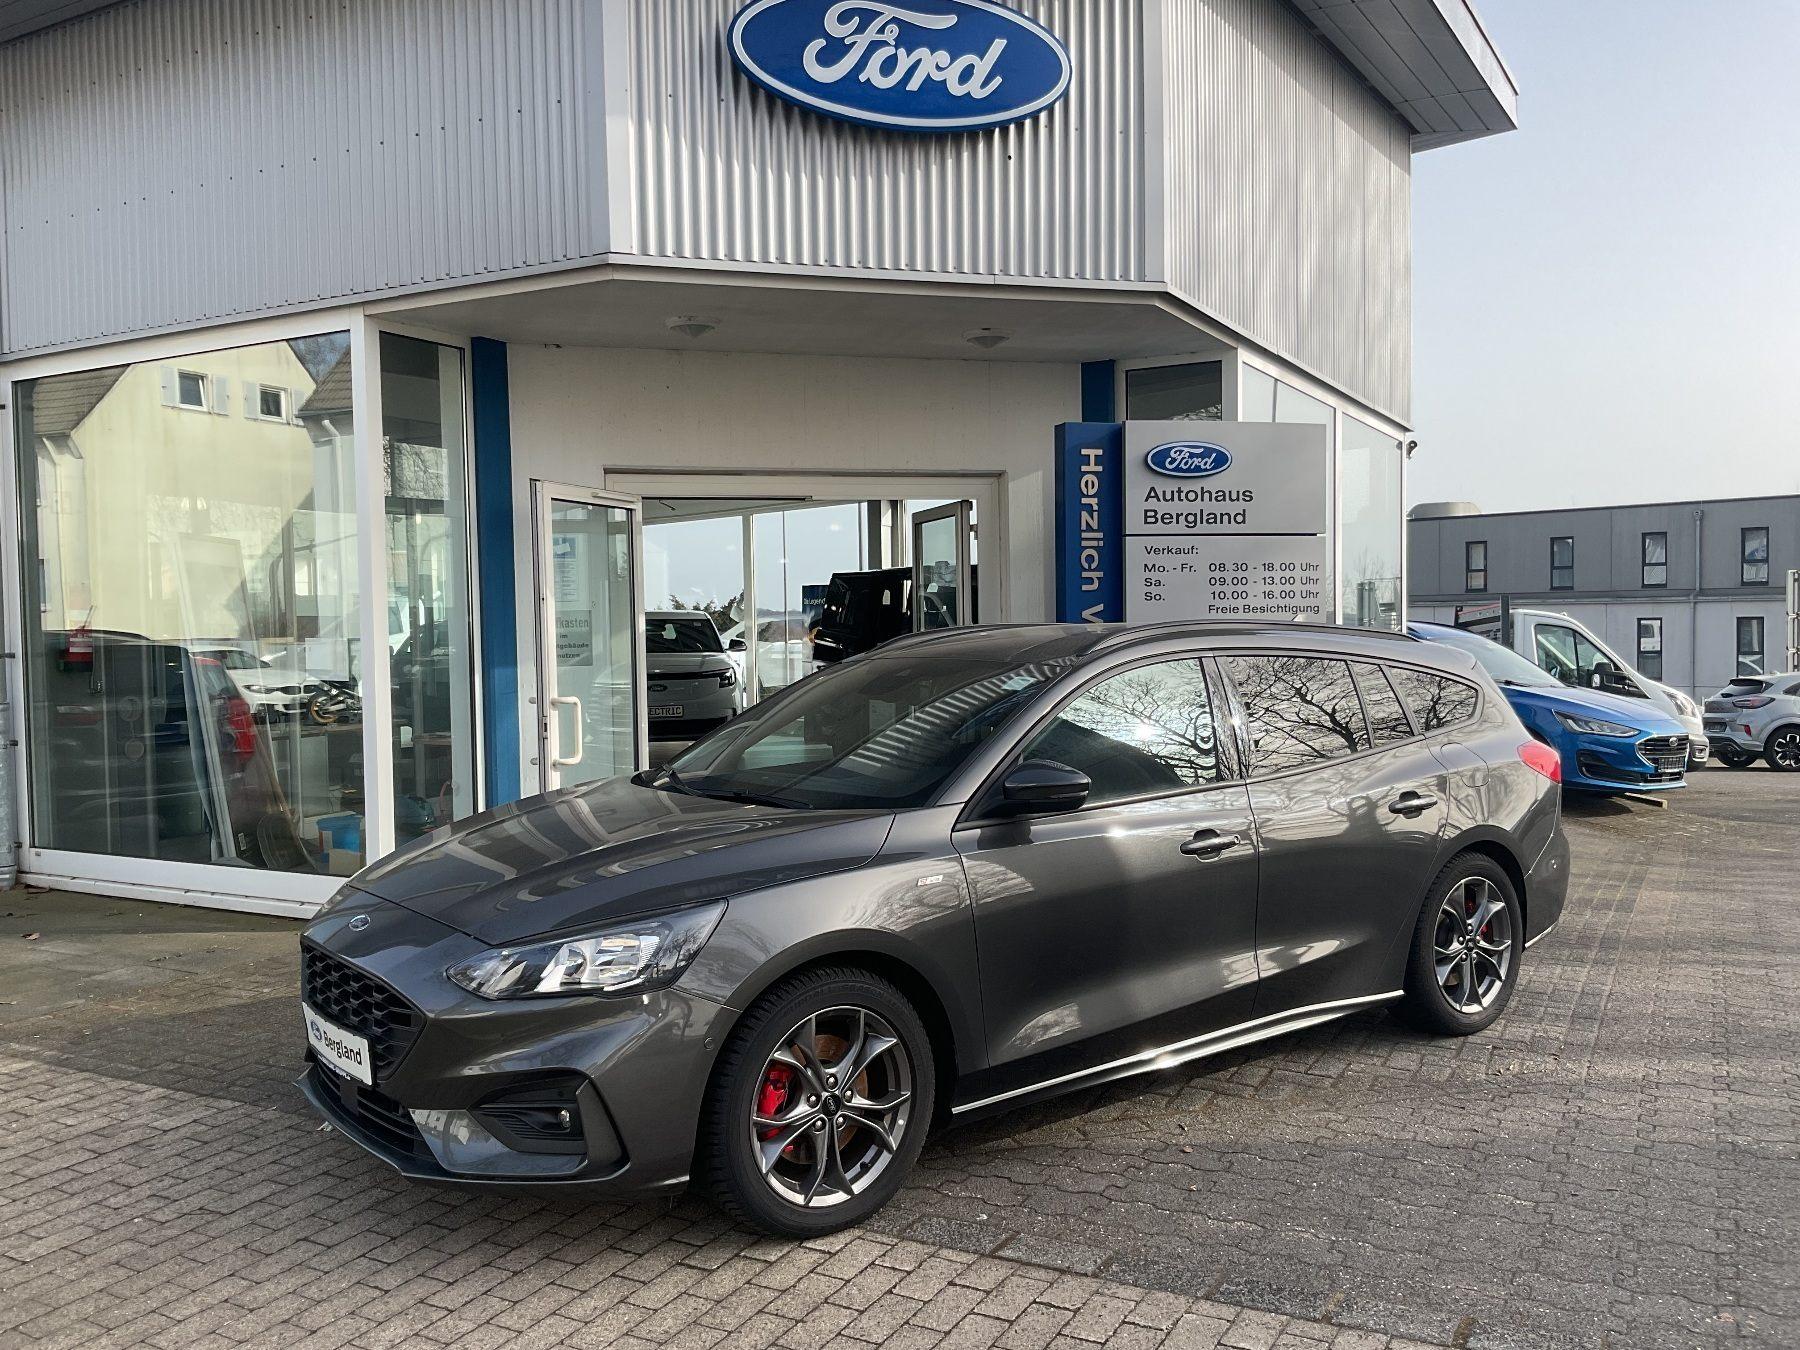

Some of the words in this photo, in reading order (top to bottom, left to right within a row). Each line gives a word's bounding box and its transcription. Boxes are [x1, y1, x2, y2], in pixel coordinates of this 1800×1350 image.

[803, 0, 1007, 99] Ford
[1165, 446, 1217, 470] Ford
[1144, 486, 1254, 503] Autohaus
[1080, 448, 1104, 592] Herzlich
[1143, 508, 1247, 529] Bergland
[1144, 545, 1199, 555] Verkauf:
[1143, 563, 1170, 573] Mo.
[1180, 563, 1197, 573] Fr.
[1208, 563, 1249, 572] 08.30
[1261, 562, 1296, 572] 18.00
[1300, 562, 1320, 571] Uhr
[1143, 577, 1166, 587] Sa.
[1208, 577, 1249, 586] 09.00
[1261, 576, 1296, 586] 13.00
[1300, 576, 1320, 585] Uhr
[1143, 591, 1166, 601] So.
[1210, 591, 1249, 600] 10.00
[1261, 590, 1296, 600] 16.00
[1300, 590, 1320, 599] Uhr
[1208, 604, 1240, 614] Freie
[1242, 603, 1320, 615] Besichtigung
[323, 1030, 363, 1066] Bergland
